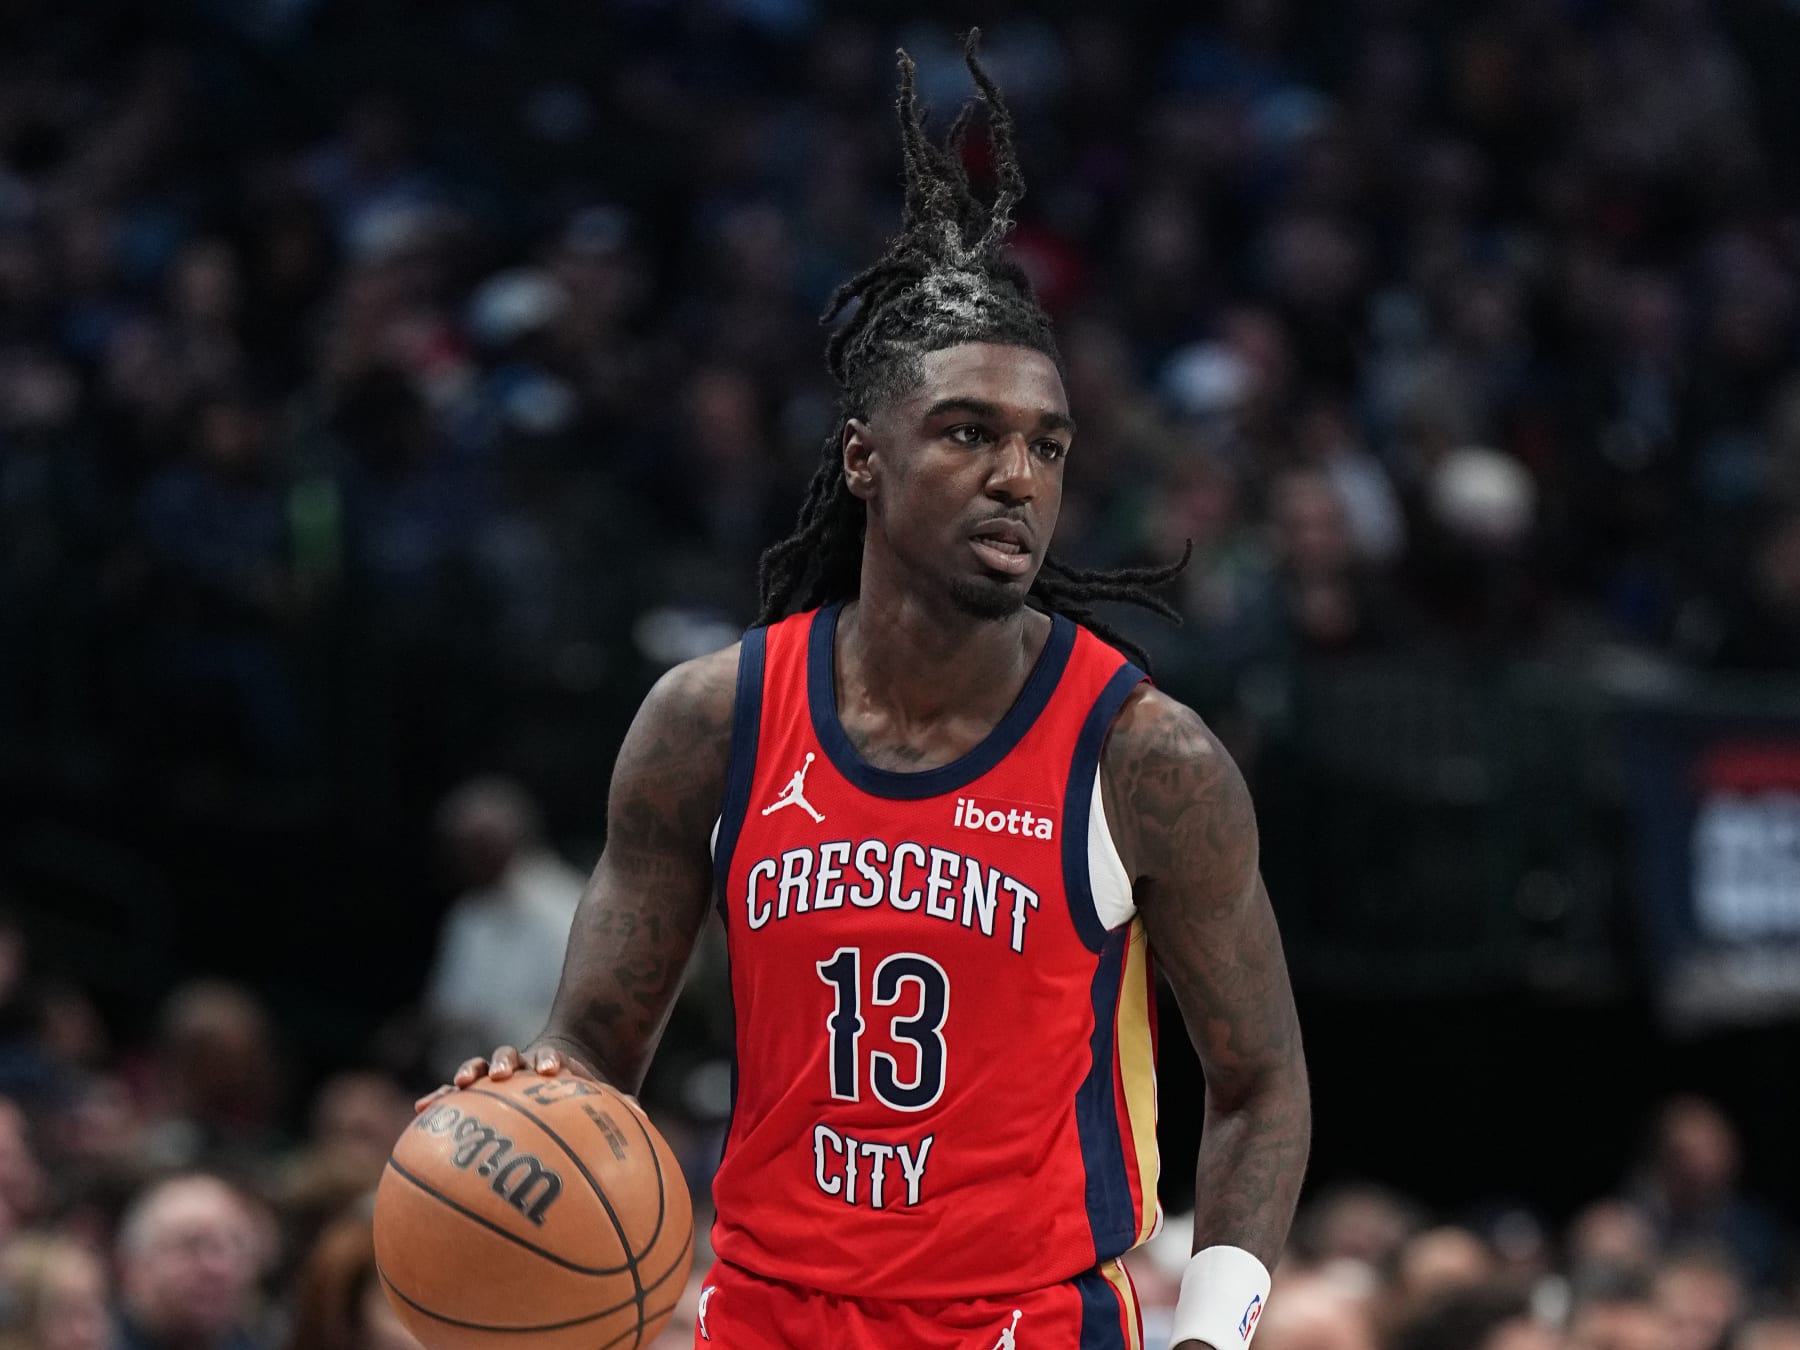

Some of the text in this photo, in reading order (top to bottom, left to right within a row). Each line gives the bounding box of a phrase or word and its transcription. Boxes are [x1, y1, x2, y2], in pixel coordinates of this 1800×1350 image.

[953, 798, 1054, 841] ibotta
[746, 839, 1040, 954] CRESCENT
[816, 947, 951, 1113] 13
[814, 1123, 935, 1208] CITY
